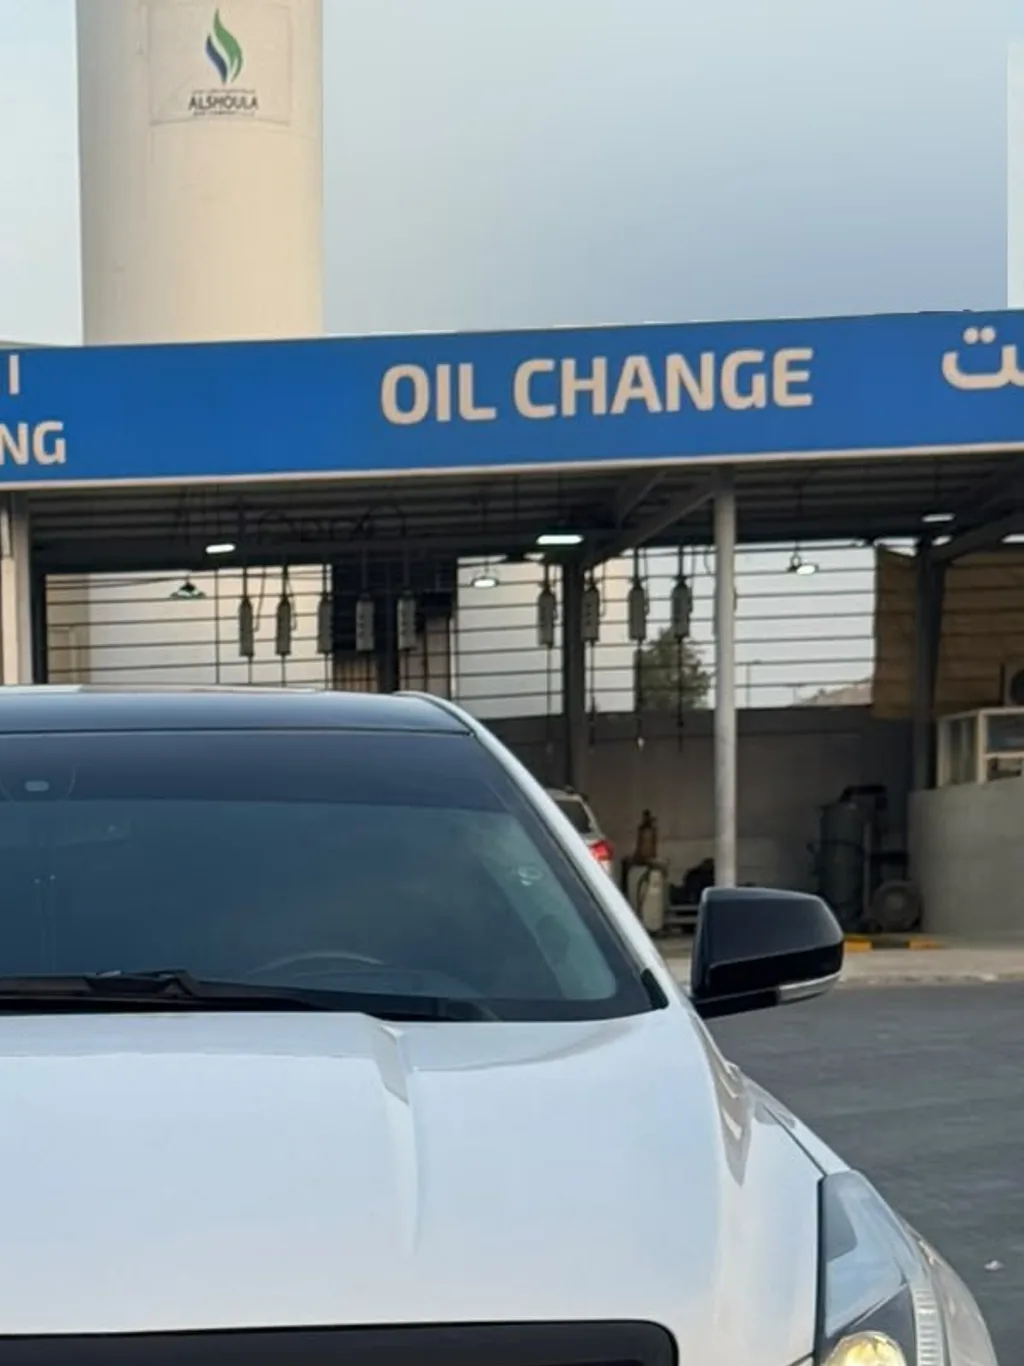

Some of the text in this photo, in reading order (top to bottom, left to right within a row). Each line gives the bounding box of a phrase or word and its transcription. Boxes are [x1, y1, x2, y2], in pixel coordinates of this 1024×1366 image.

[188, 95, 259, 111] ALSHOULA
[380, 347, 813, 425] OIL CHANGE
